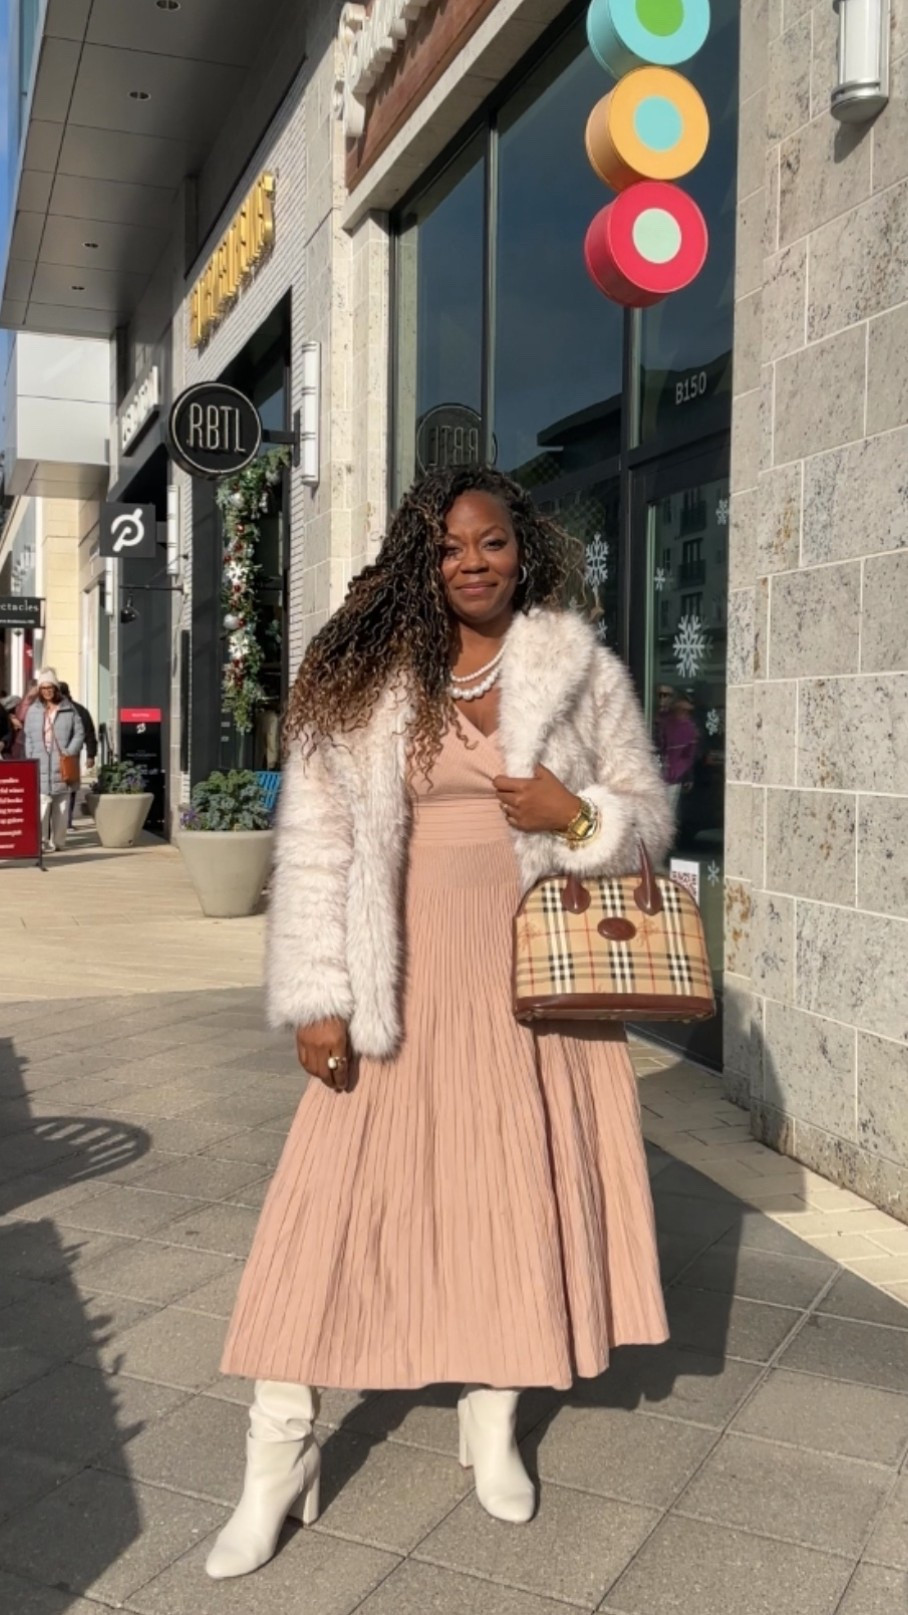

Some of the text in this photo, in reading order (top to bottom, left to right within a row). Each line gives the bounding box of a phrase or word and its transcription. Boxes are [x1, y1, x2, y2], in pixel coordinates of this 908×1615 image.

[675, 371, 707, 405] B150
[188, 402, 247, 454] RBTL
[0, 599, 39, 612] ctacles
